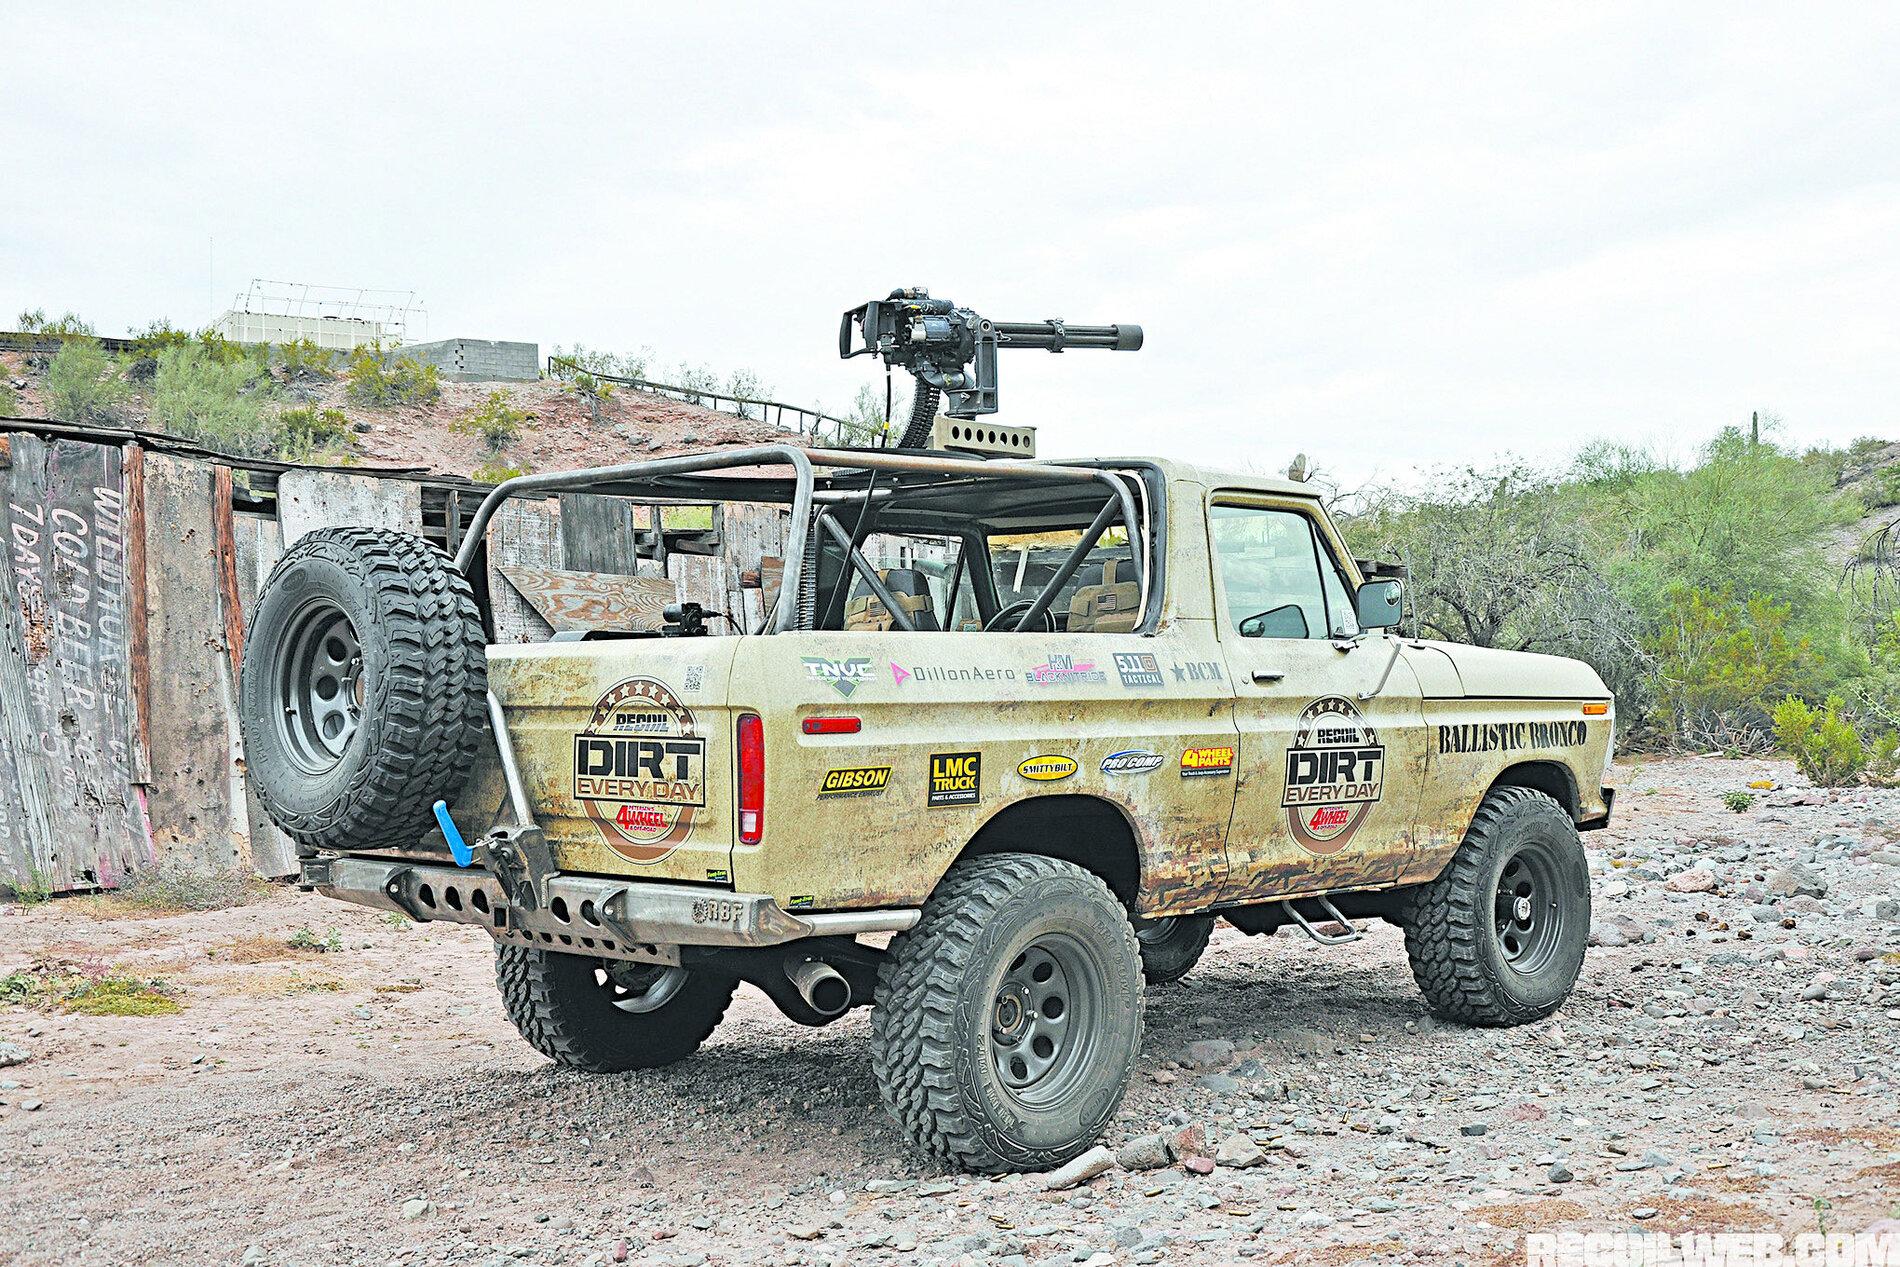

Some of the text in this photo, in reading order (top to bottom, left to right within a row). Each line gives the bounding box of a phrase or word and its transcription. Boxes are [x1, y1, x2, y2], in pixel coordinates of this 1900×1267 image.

[9, 502, 44, 526] 7
[52, 508, 89, 605] COLD
[58, 610, 96, 710] BEER
[98, 586, 126, 716] HORE
[913, 666, 1016, 681] DillonAero
[1122, 674, 1162, 684] TACTICAL
[1185, 661, 1223, 680] BCM
[613, 713, 669, 732] RECOIL
[1317, 727, 1360, 744] RECOIL
[1438, 720, 1588, 754] BALLISTIC BRONCO
[577, 739, 701, 780] DIRT
[1101, 755, 1164, 770] PRO COMP
[1181, 747, 1233, 767] 4 WHEEL
[1198, 757, 1231, 767] PARTS
[933, 757, 976, 778] LMC
[1022, 763, 1072, 774] SMITTYBILT
[1288, 750, 1382, 785] DIRT
[577, 777, 700, 800] EVERY DAY
[826, 769, 888, 789] GIBSON
[933, 776, 976, 791] TRUCK
[1285, 782, 1379, 802] EVERY DAY
[616, 804, 668, 830] 4 WHEEL
[1309, 807, 1323, 831] 4
[707, 899, 743, 922] RBF
